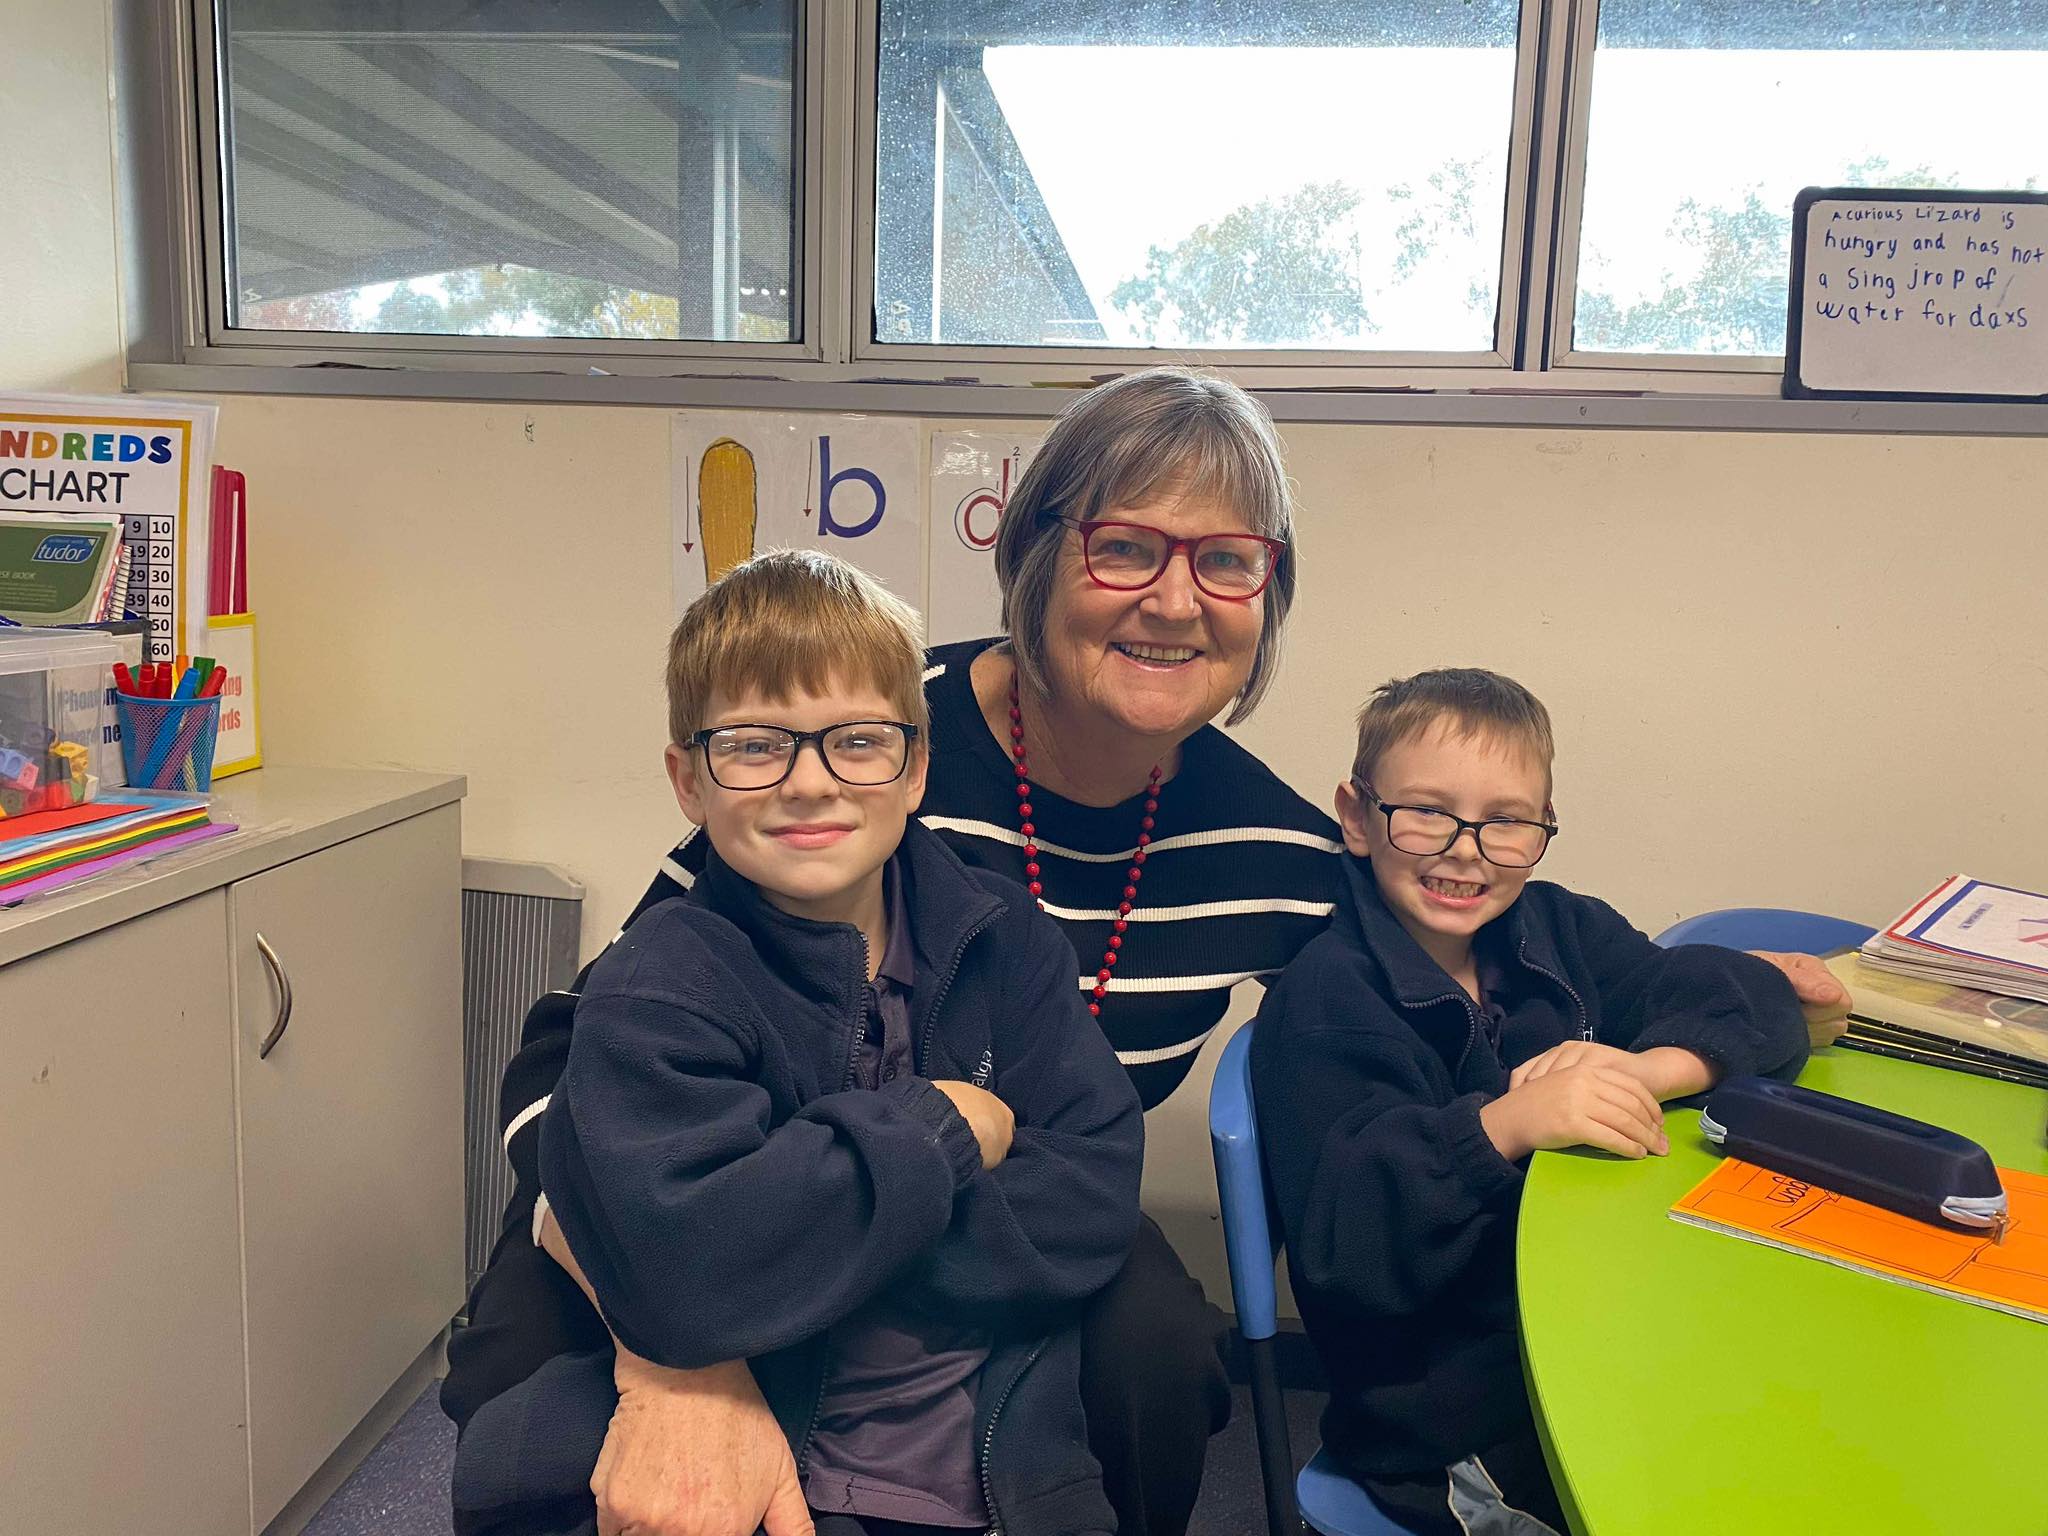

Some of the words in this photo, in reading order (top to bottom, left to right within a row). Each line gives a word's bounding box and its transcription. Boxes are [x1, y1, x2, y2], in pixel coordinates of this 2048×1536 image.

[1845, 208, 1903, 222] curious
[2002, 212, 2015, 229] is
[1825, 229, 1897, 258] hungry
[1913, 233, 1946, 250] and
[1966, 236, 1999, 255] has
[2012, 246, 2045, 264] not
[1819, 273, 1828, 288] a
[1976, 267, 1997, 289] of
[1922, 299, 1958, 327] for
[0, 468, 130, 503] CHART
[818, 436, 886, 537] b
[964, 458, 1010, 546] d
[132, 521, 141, 532] 9
[152, 521, 170, 534] 10
[38, 544, 85, 561] tudor
[131, 546, 146, 558] 19
[152, 546, 170, 558] 20
[129, 570, 146, 582] 29
[152, 570, 170, 583] 30
[127, 594, 146, 607] 39
[151, 594, 170, 607] 40
[152, 619, 169, 631] 50
[152, 643, 170, 656] 60
